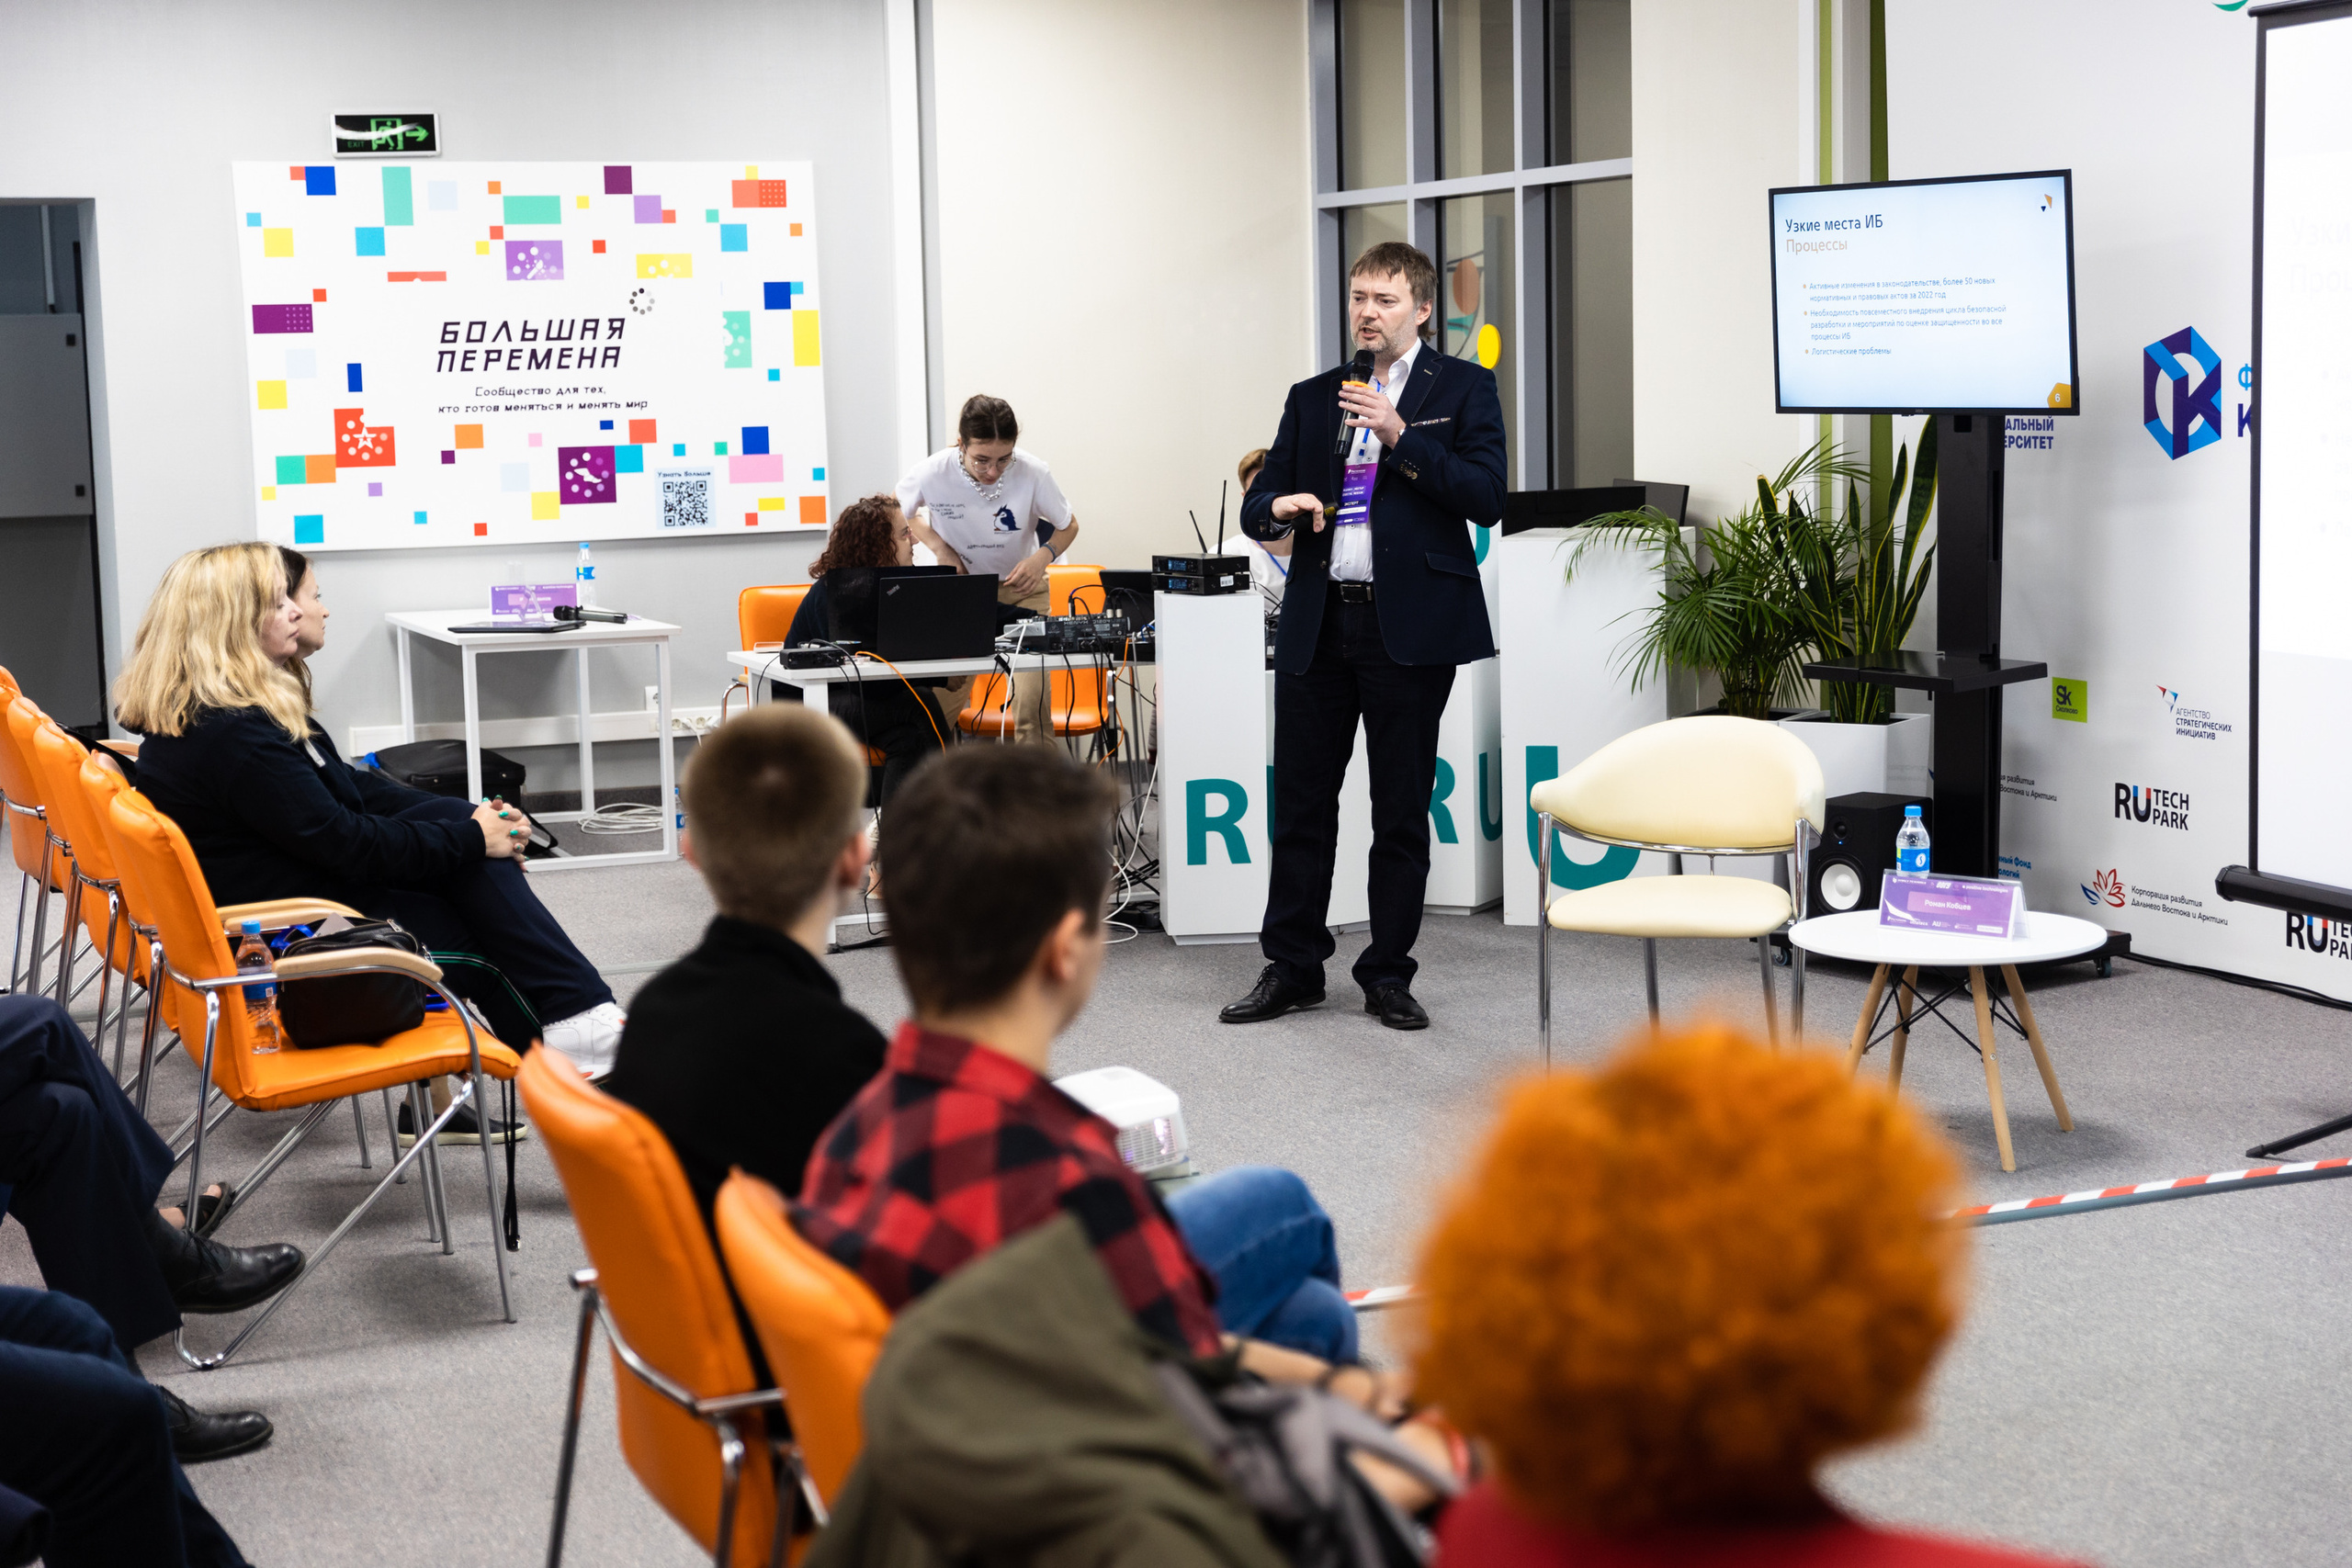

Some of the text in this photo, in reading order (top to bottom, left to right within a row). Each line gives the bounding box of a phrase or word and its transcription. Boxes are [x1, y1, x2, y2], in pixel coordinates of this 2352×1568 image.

[1785, 214, 1883, 232] Узкие места ИБ
[1786, 239, 1848, 255] Процессы
[1942, 277, 1963, 286] более
[1964, 276, 1973, 285] 50
[1917, 291, 1933, 299] 2022
[1934, 291, 1947, 299] год
[1810, 309, 1859, 317] Необходимость
[1908, 308, 1944, 316] внедрения
[1966, 305, 2007, 313] безопасной
[440, 318, 626, 344] БОЛЬШАЯ
[1811, 320, 1846, 329] разработки
[1852, 320, 1894, 328] мероприятий
[1841, 332, 1851, 340] ИБ
[1858, 346, 1892, 355] проблемы
[436, 346, 621, 373] ПЕРЕМЕНА
[475, 386, 606, 398] Сообщество для тех,
[2054, 393, 2061, 402] 6
[437, 400, 648, 413] кто готов меняться и менять мир
[2055, 684, 2072, 706] Sk
[2055, 705, 2078, 715] Сколково
[2176, 707, 2211, 720] АГЕНТСТВО
[2176, 717, 2233, 732] СТРАТЕГИЧЕСКИХ
[2176, 728, 2216, 740] ИНИЦИАТИВ
[2007, 774, 2035, 786] развития
[2000, 784, 2025, 796] Востока
[2030, 790, 2057, 802] Арктики
[2115, 782, 2189, 823] RU TECH
[2153, 808, 2189, 831] PARK
[2014, 856, 2031, 870] Фонд
[1924, 899, 1946, 908] Роман
[2132, 886, 2203, 908] Корпорация развития
[2131, 898, 2161, 911] Дальнего
[2162, 904, 2190, 918] Востока
[2197, 912, 2228, 926] Арктики
[2330, 938, 2352, 961] PA
